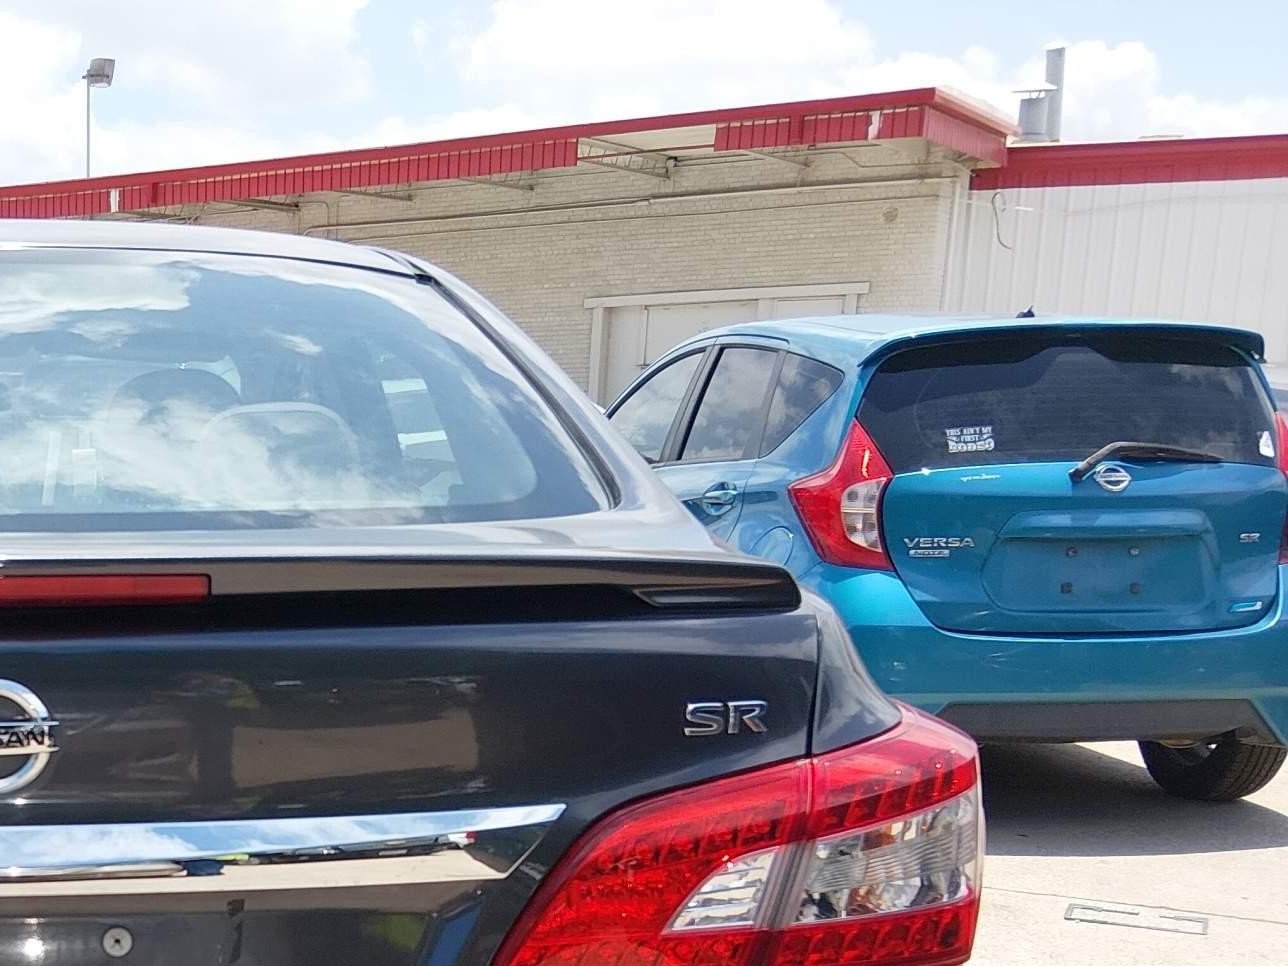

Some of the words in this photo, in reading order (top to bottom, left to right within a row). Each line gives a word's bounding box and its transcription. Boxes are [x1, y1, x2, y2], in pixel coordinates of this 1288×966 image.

[903, 537, 975, 548] VERSA
[1239, 532, 1261, 543] SR
[683, 700, 769, 736] SR
